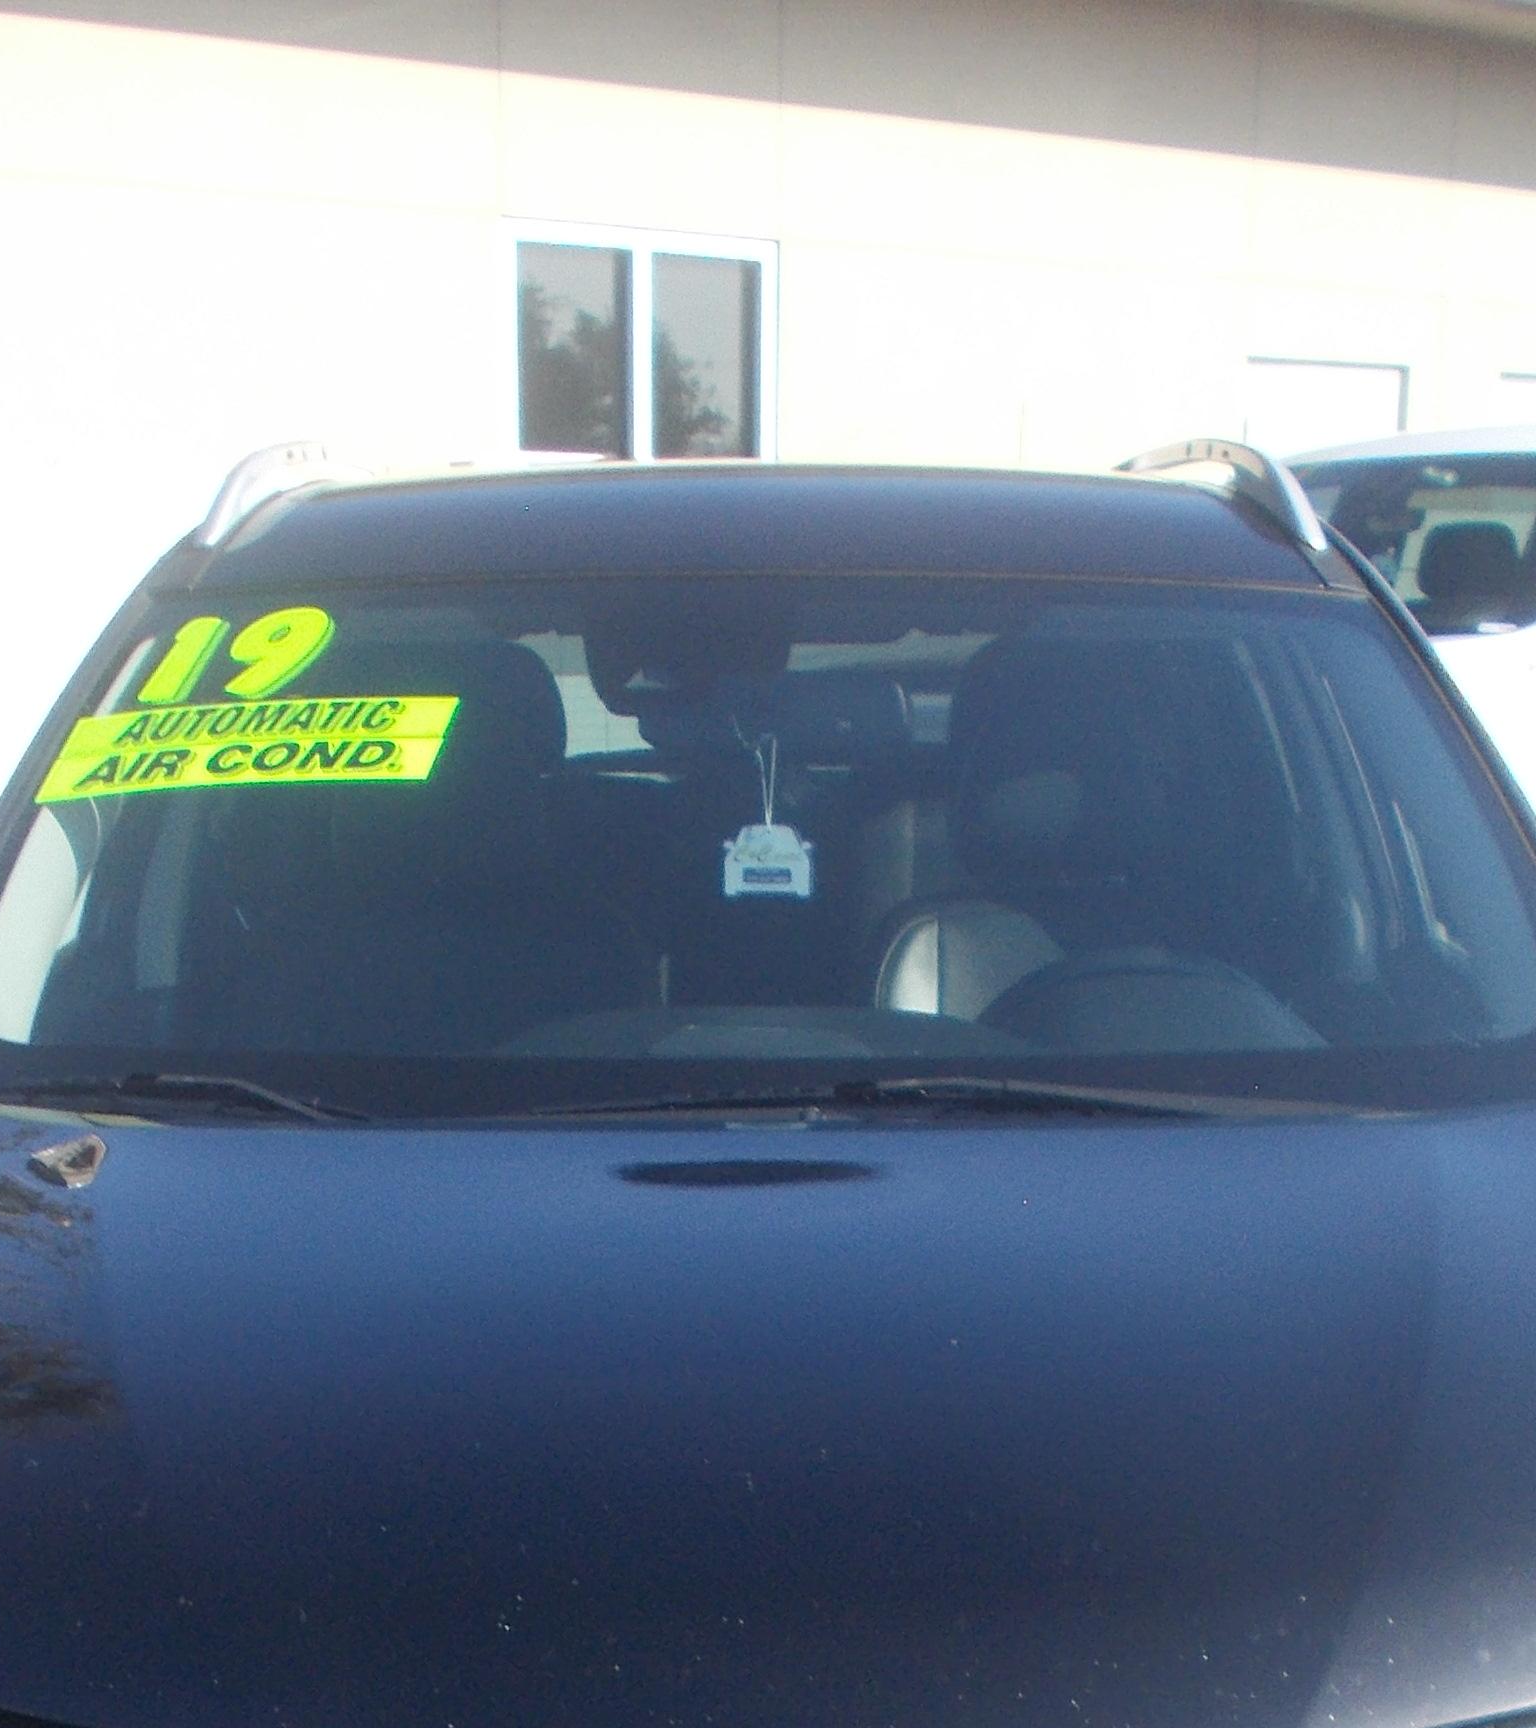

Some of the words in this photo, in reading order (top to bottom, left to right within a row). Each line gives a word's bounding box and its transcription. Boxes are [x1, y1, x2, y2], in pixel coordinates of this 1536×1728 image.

[137, 606, 336, 702] 19
[113, 700, 404, 746] AUTOMATIC
[74, 747, 195, 792] AIR
[204, 740, 403, 776] COND.
